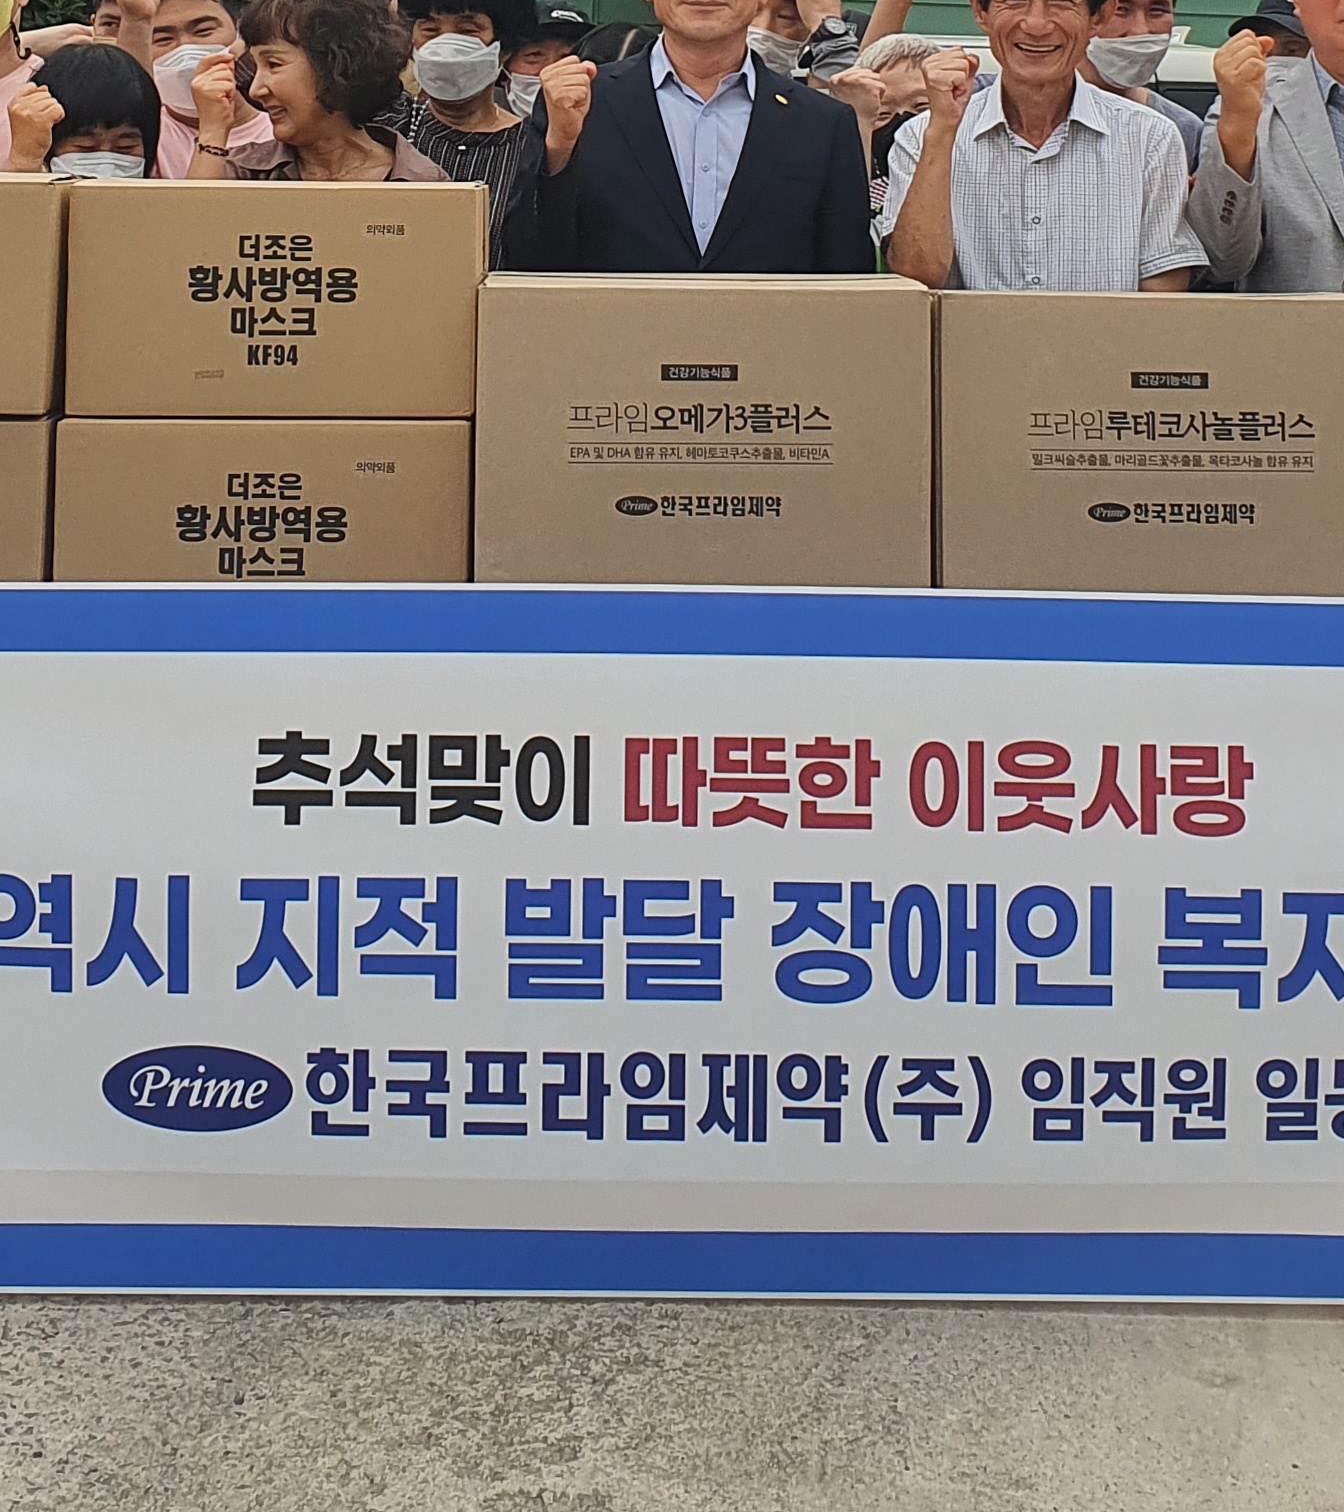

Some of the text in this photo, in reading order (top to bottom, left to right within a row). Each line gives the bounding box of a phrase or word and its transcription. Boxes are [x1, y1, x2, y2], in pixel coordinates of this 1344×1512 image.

[366, 224, 406, 236] 의약외품
[238, 234, 314, 262] 더조은
[187, 266, 359, 304] 황사방역용
[229, 306, 317, 338] 마스크
[246, 344, 299, 366] KF94
[668, 367, 732, 379] 건강기능식품
[1138, 375, 1202, 387] 건강기능식품
[566, 402, 832, 434] 프라임오메가3플러스
[1027, 409, 1316, 442] 프라임루테코사놀플러스
[570, 447, 590, 458] EPA
[593, 446, 604, 460] 및
[607, 447, 631, 458] DHA
[634, 447, 656, 460] 함유
[789, 446, 830, 460] 비타민A
[1291, 455, 1313, 468] 유지
[354, 461, 396, 474] 의약외품
[226, 473, 303, 500] 더조은
[622, 495, 782, 518] Prime 한국프라임제약
[1133, 502, 1256, 525] 한국프라임제약
[175, 505, 349, 543] 황사방역용
[218, 546, 306, 578] 마스크
[252, 732, 1255, 837] 추석맞이 따뜻한 이웃사랑
[235, 874, 458, 1000] 지적
[503, 874, 735, 1002] 발달
[769, 878, 1114, 1010] 장애인
[128, 1062, 269, 1112] Prime
[1019, 1056, 1229, 1144] 임직원
